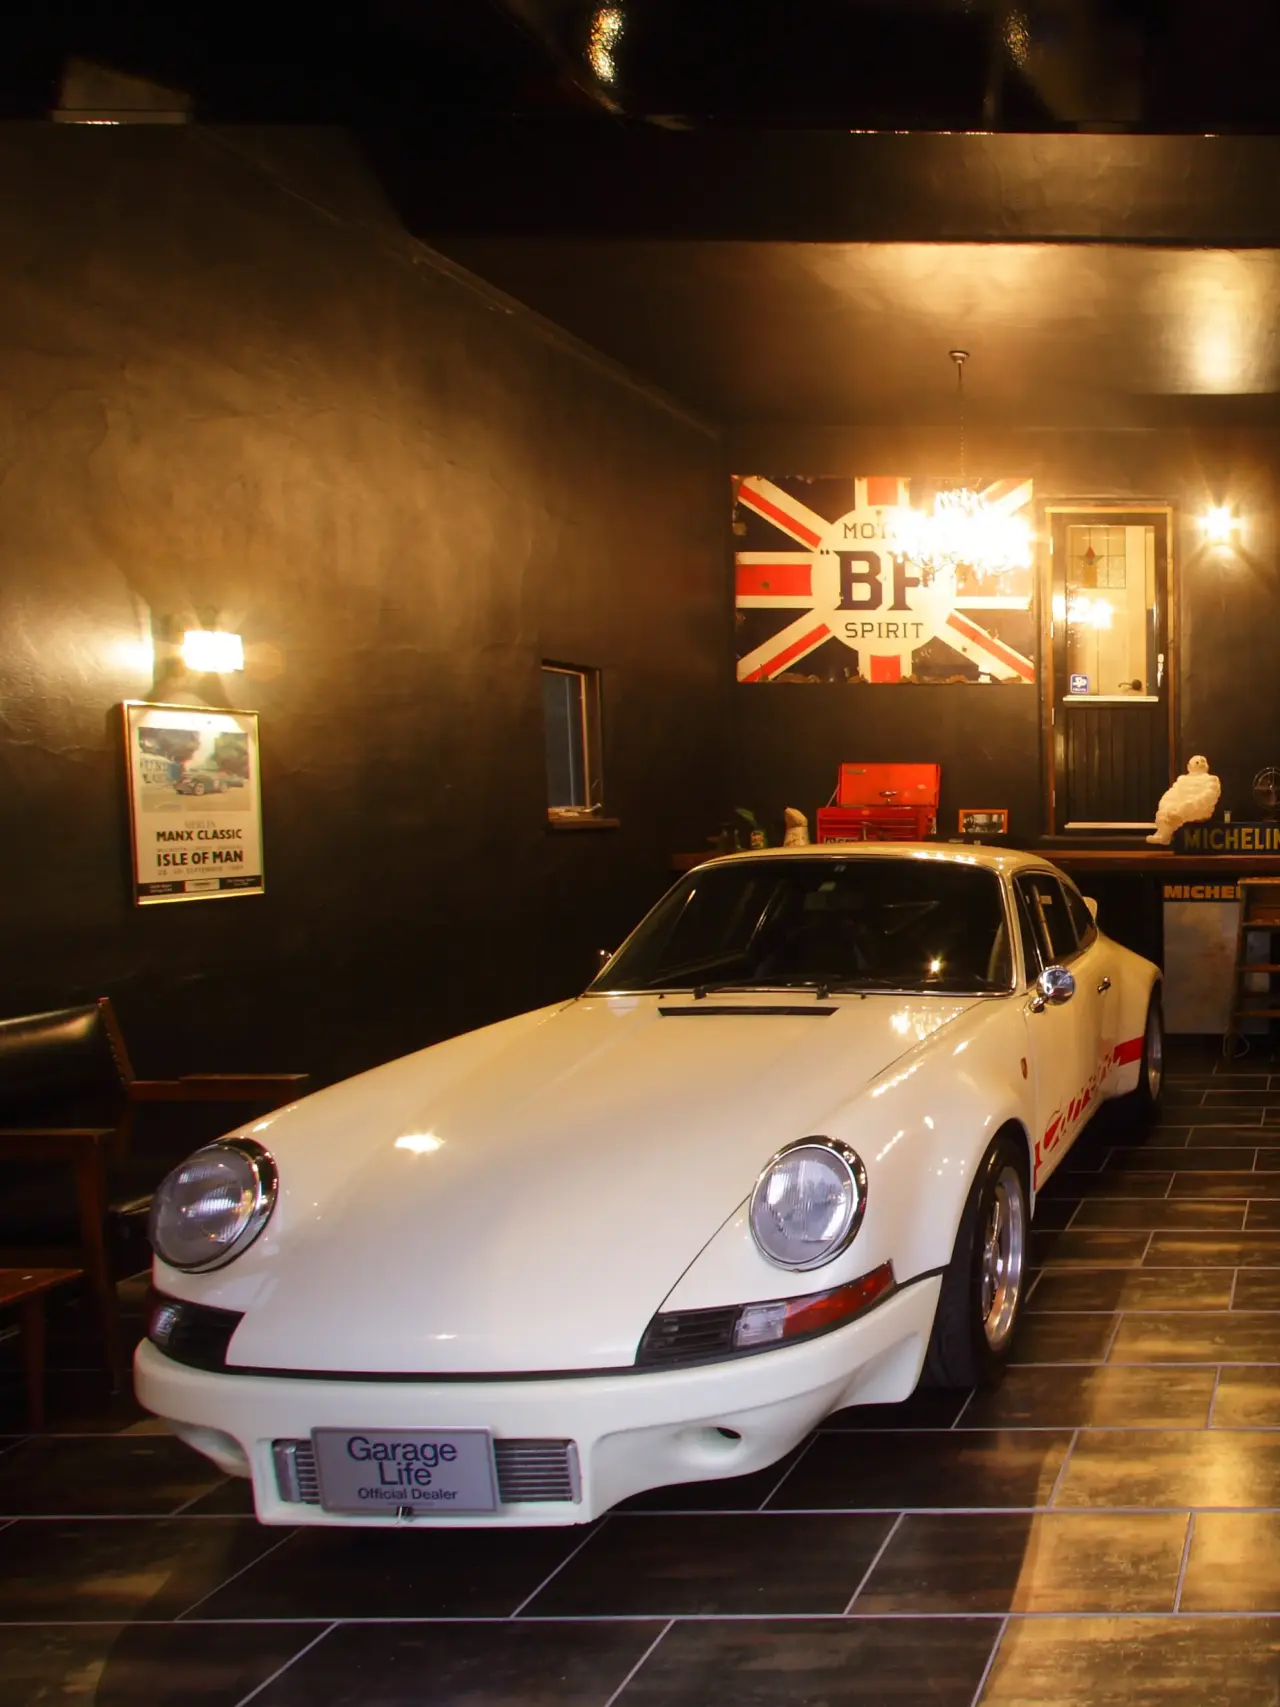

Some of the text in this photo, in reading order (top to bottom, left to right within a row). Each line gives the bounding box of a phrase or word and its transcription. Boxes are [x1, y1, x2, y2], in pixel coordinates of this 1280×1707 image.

[844, 622, 924, 639] SPIRIT
[156, 829, 242, 842] MANX CLASSIC
[157, 851, 243, 867] ISLE OF MAN
[346, 1436, 458, 1468] Garage
[378, 1461, 433, 1486] Life
[357, 1487, 458, 1501] Official Dealer
